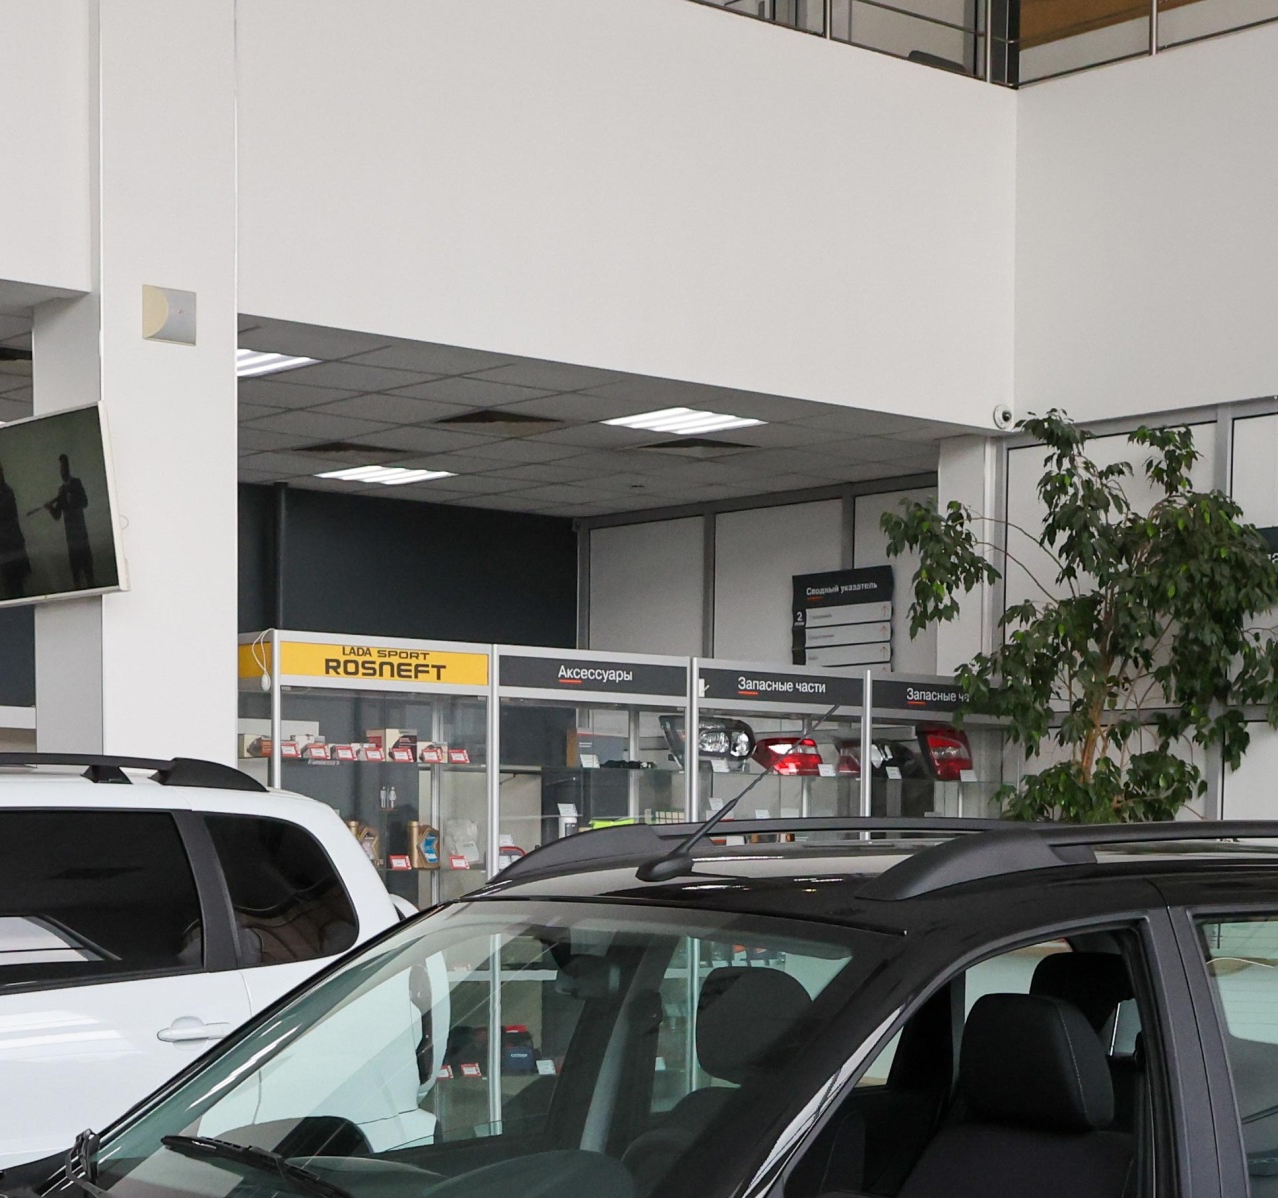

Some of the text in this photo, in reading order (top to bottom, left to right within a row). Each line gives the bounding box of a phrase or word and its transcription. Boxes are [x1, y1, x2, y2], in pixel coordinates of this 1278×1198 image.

[806, 582, 878, 596] Сводный указатель
[797, 612, 803, 621] 2
[342, 646, 430, 660] LADA SPORT
[325, 658, 446, 680] ROSNEFT
[558, 665, 633, 683] Аксессуары
[738, 677, 826, 693] Запасные части
[906, 688, 956, 702] Запасные
